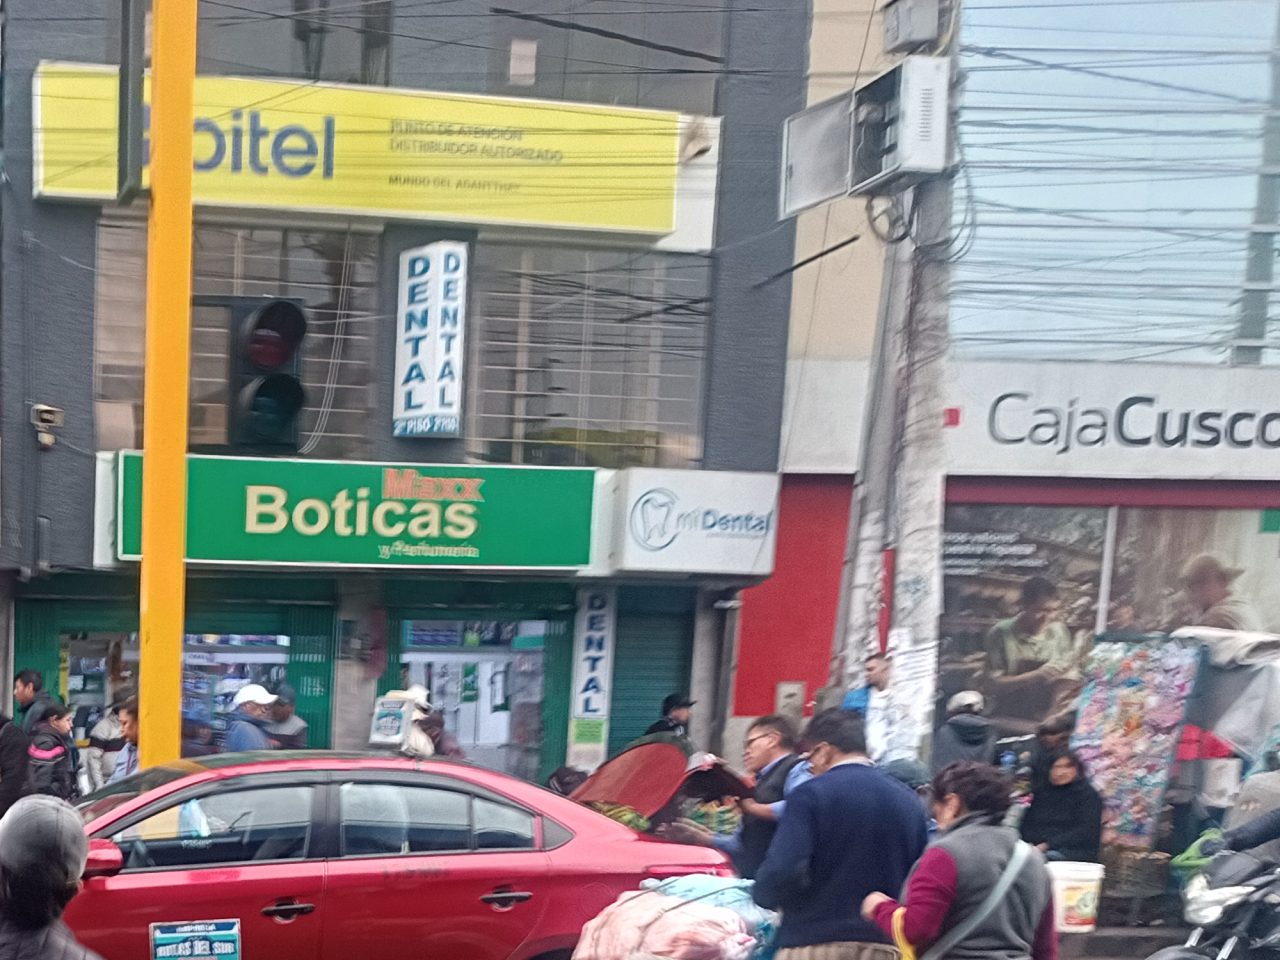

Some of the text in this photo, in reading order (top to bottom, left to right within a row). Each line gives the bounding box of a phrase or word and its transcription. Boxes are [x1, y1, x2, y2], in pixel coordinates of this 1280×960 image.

[390, 137, 563, 163] DISTRIBUIDOR AUTORIZADO
[438, 122, 456, 136] DE
[401, 256, 431, 412] DENTAL
[437, 251, 461, 409] DENTAL
[245, 485, 478, 539] Boticas
[580, 594, 607, 713] DENTAL
